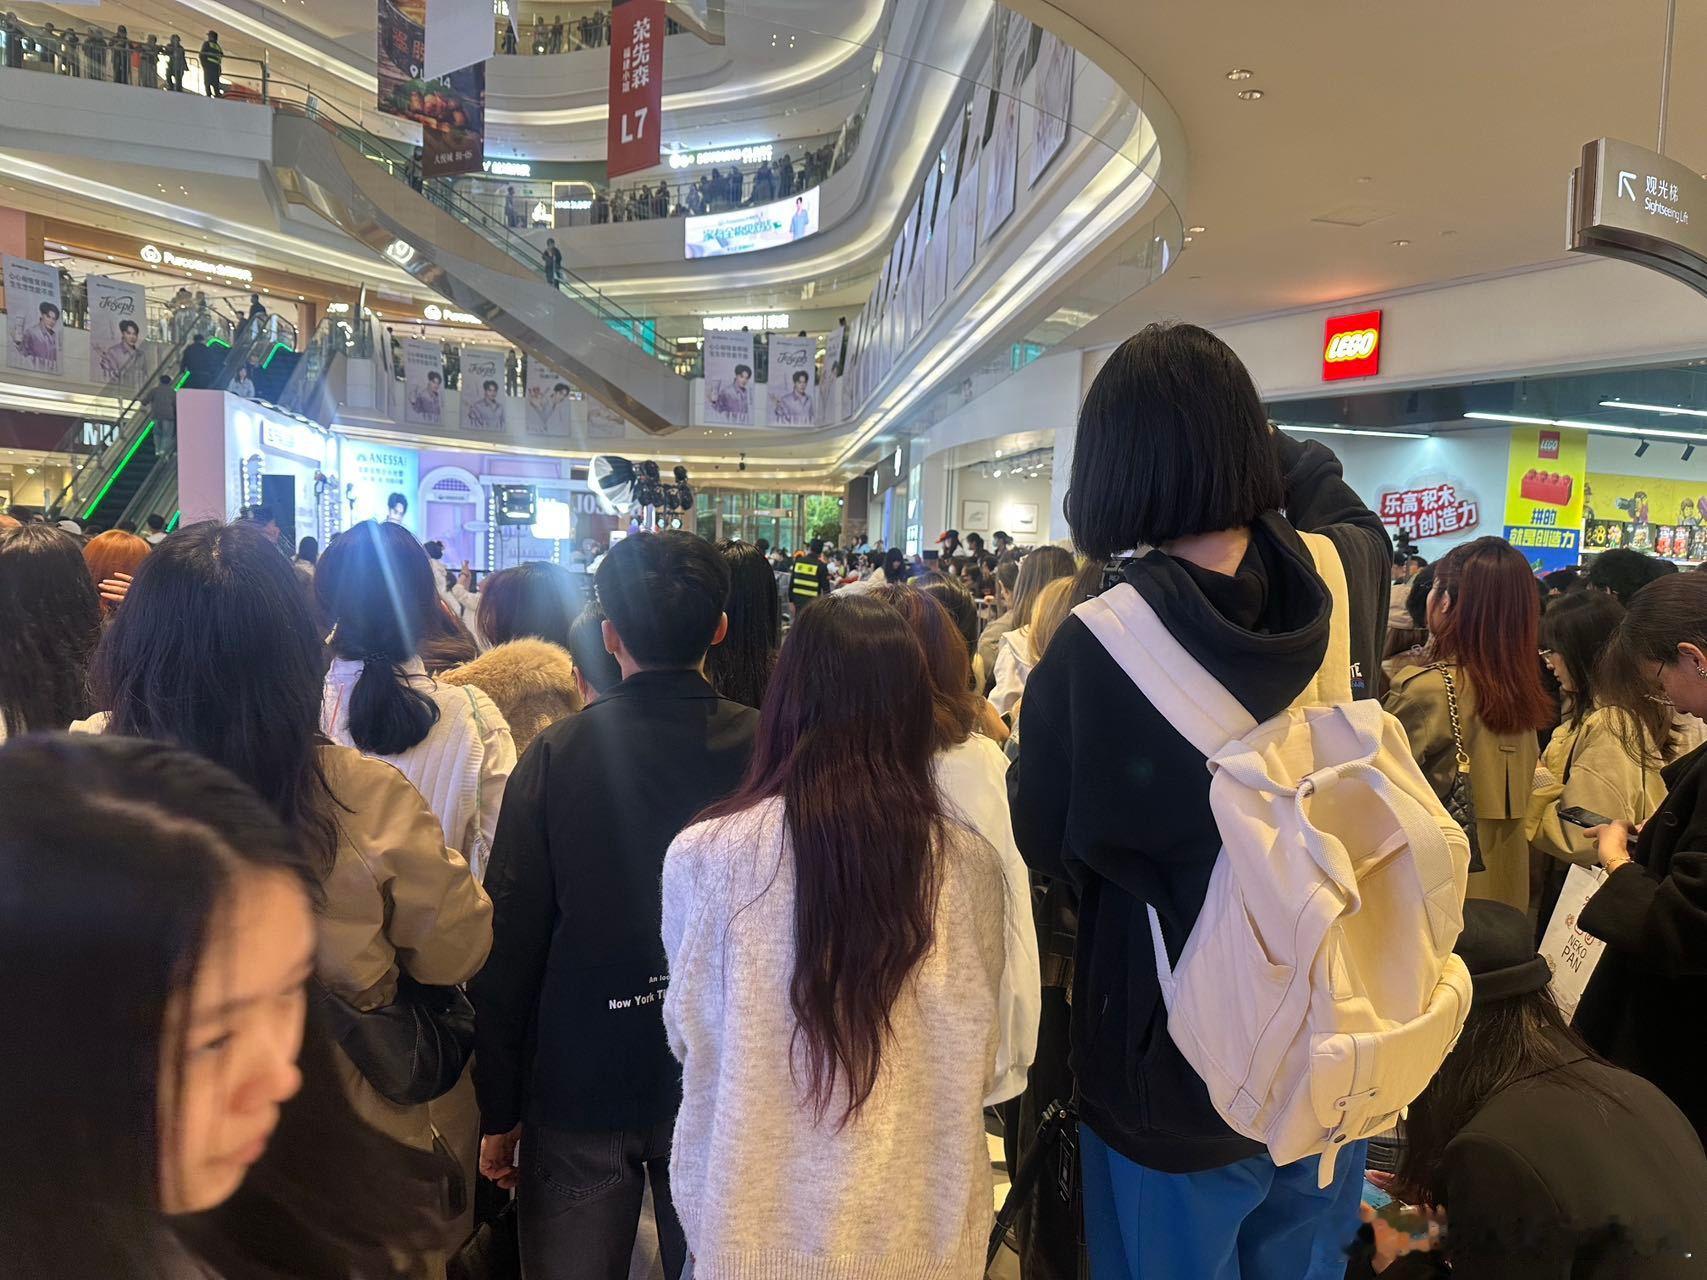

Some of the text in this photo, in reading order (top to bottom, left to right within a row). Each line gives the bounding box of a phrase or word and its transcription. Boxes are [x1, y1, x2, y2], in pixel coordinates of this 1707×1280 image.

[620, 107, 648, 144] L7
[1645, 175, 1679, 203] 观光梯
[1644, 197, 1689, 225] Sightseeing Lift
[99, 295, 136, 315] Joseph
[1326, 330, 1377, 361] LEGO
[777, 349, 808, 367] Joseph
[1540, 439, 1558, 453] LEGO
[370, 453, 404, 466] ANESSA
[1384, 485, 1456, 514] 乐高积木
[1530, 508, 1557, 526] 拼的
[1509, 527, 1576, 549] 就是创造力
[1567, 934, 1588, 959] NEKO
[1561, 945, 1583, 973] PAN
[648, 976, 658, 984] An
[608, 999, 632, 1010] Now
[634, 992, 655, 1006] York
